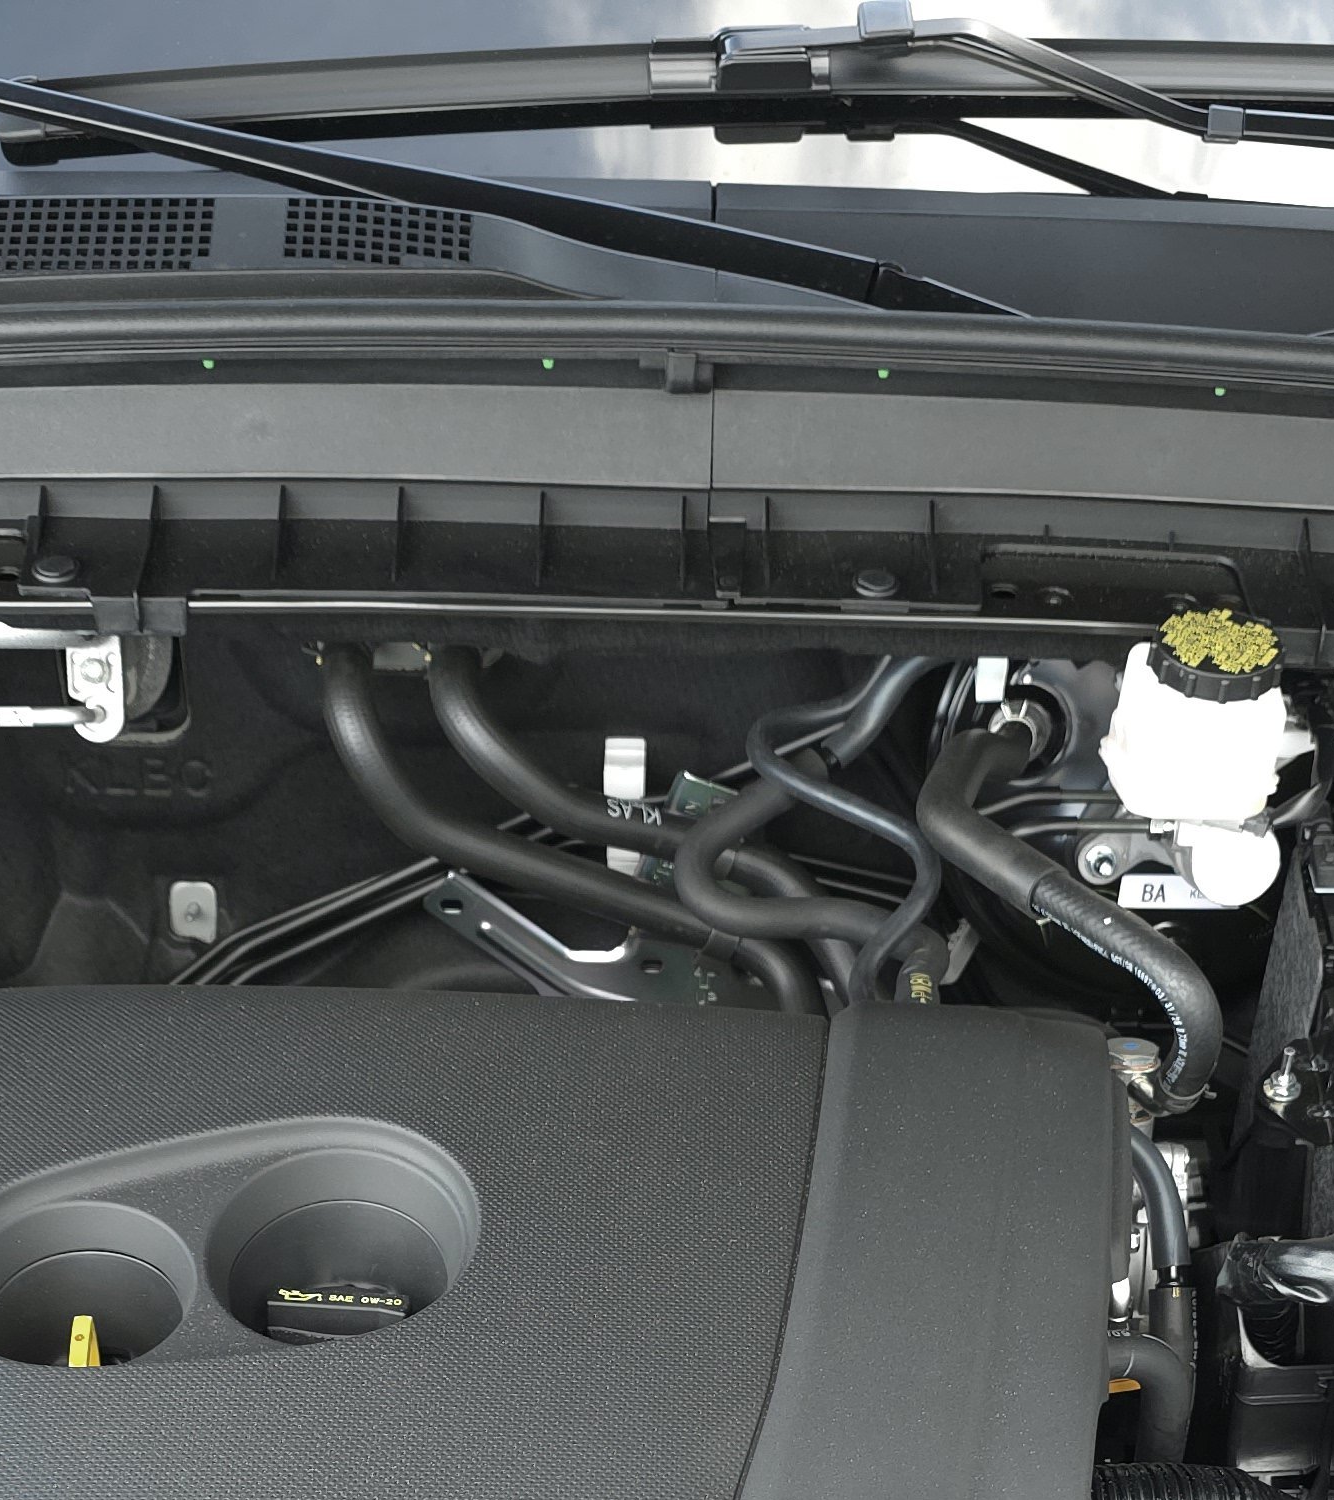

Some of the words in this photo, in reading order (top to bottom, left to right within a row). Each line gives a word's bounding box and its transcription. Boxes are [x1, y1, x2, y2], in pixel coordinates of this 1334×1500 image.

[1141, 883, 1166, 903] BA
[328, 1294, 354, 1303] SAE
[360, 1296, 403, 1306] 0W-20
